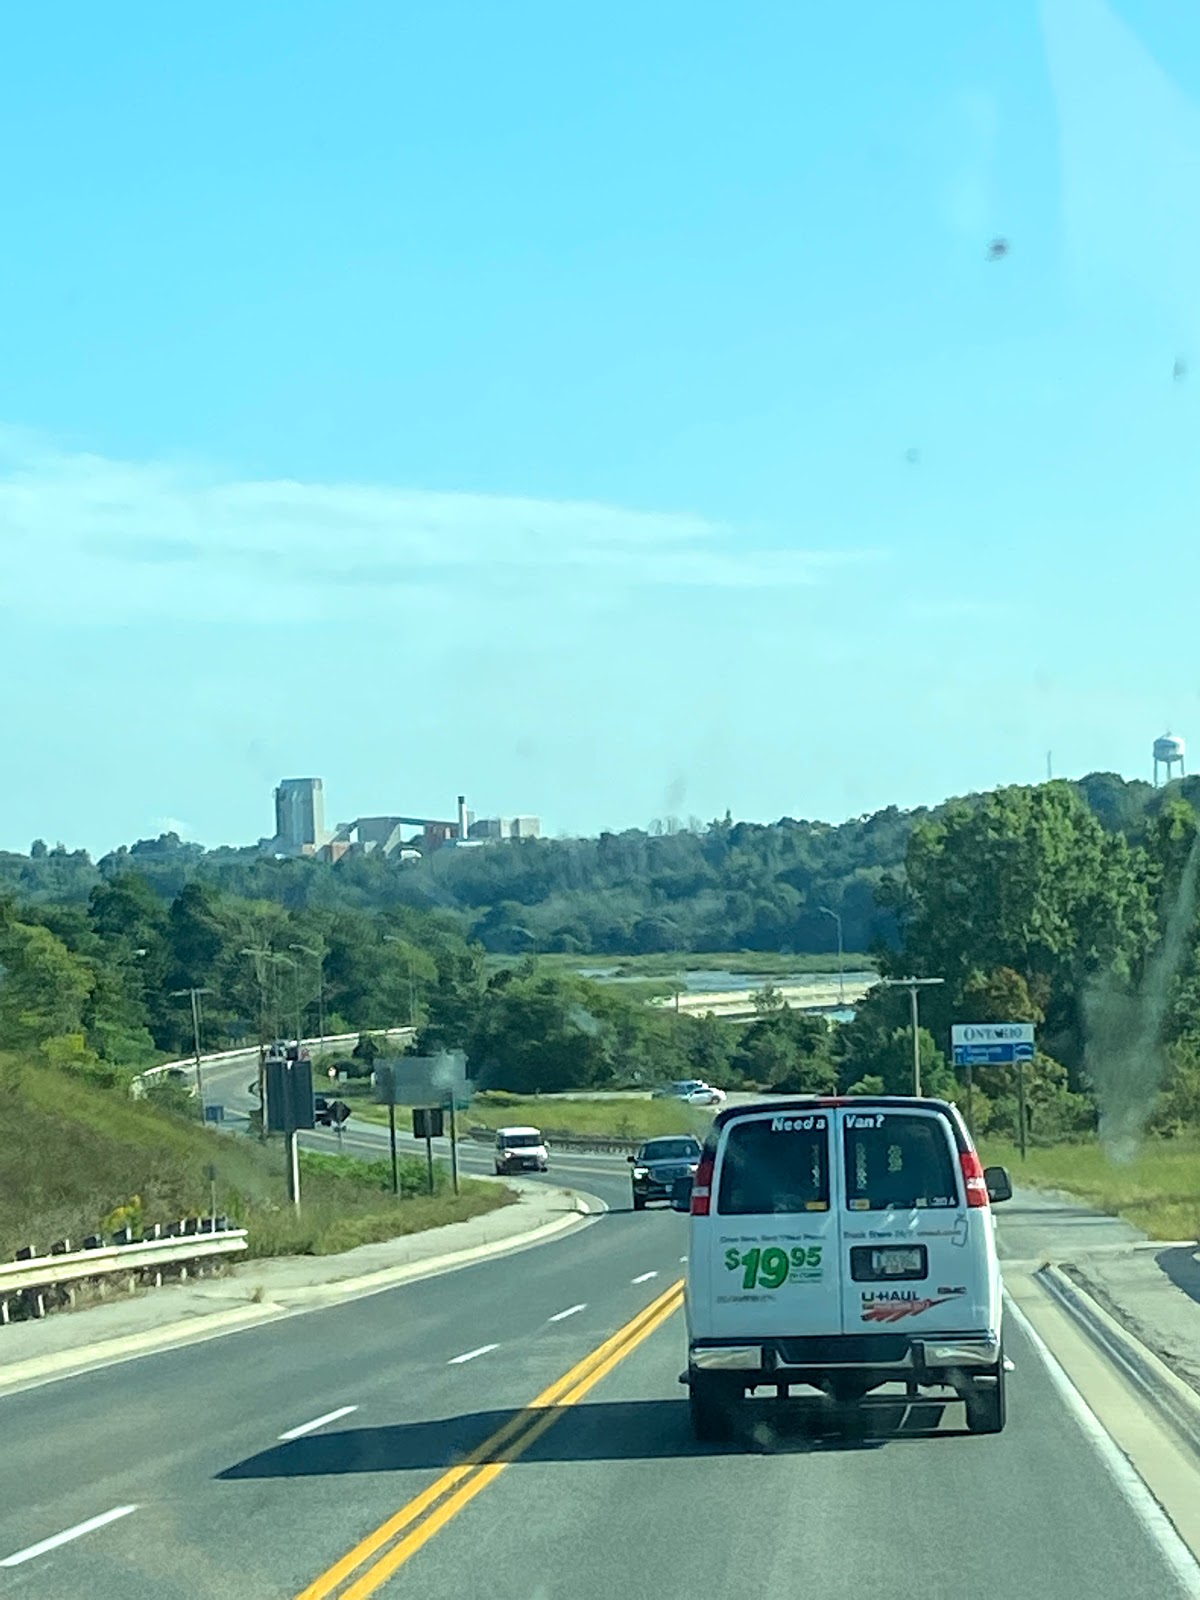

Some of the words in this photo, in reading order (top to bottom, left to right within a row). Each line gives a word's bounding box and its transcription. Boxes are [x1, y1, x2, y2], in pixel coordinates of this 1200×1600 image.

[771, 1116, 814, 1131] Need
[816, 1118, 826, 1129] a
[846, 1114, 884, 1128] Van?
